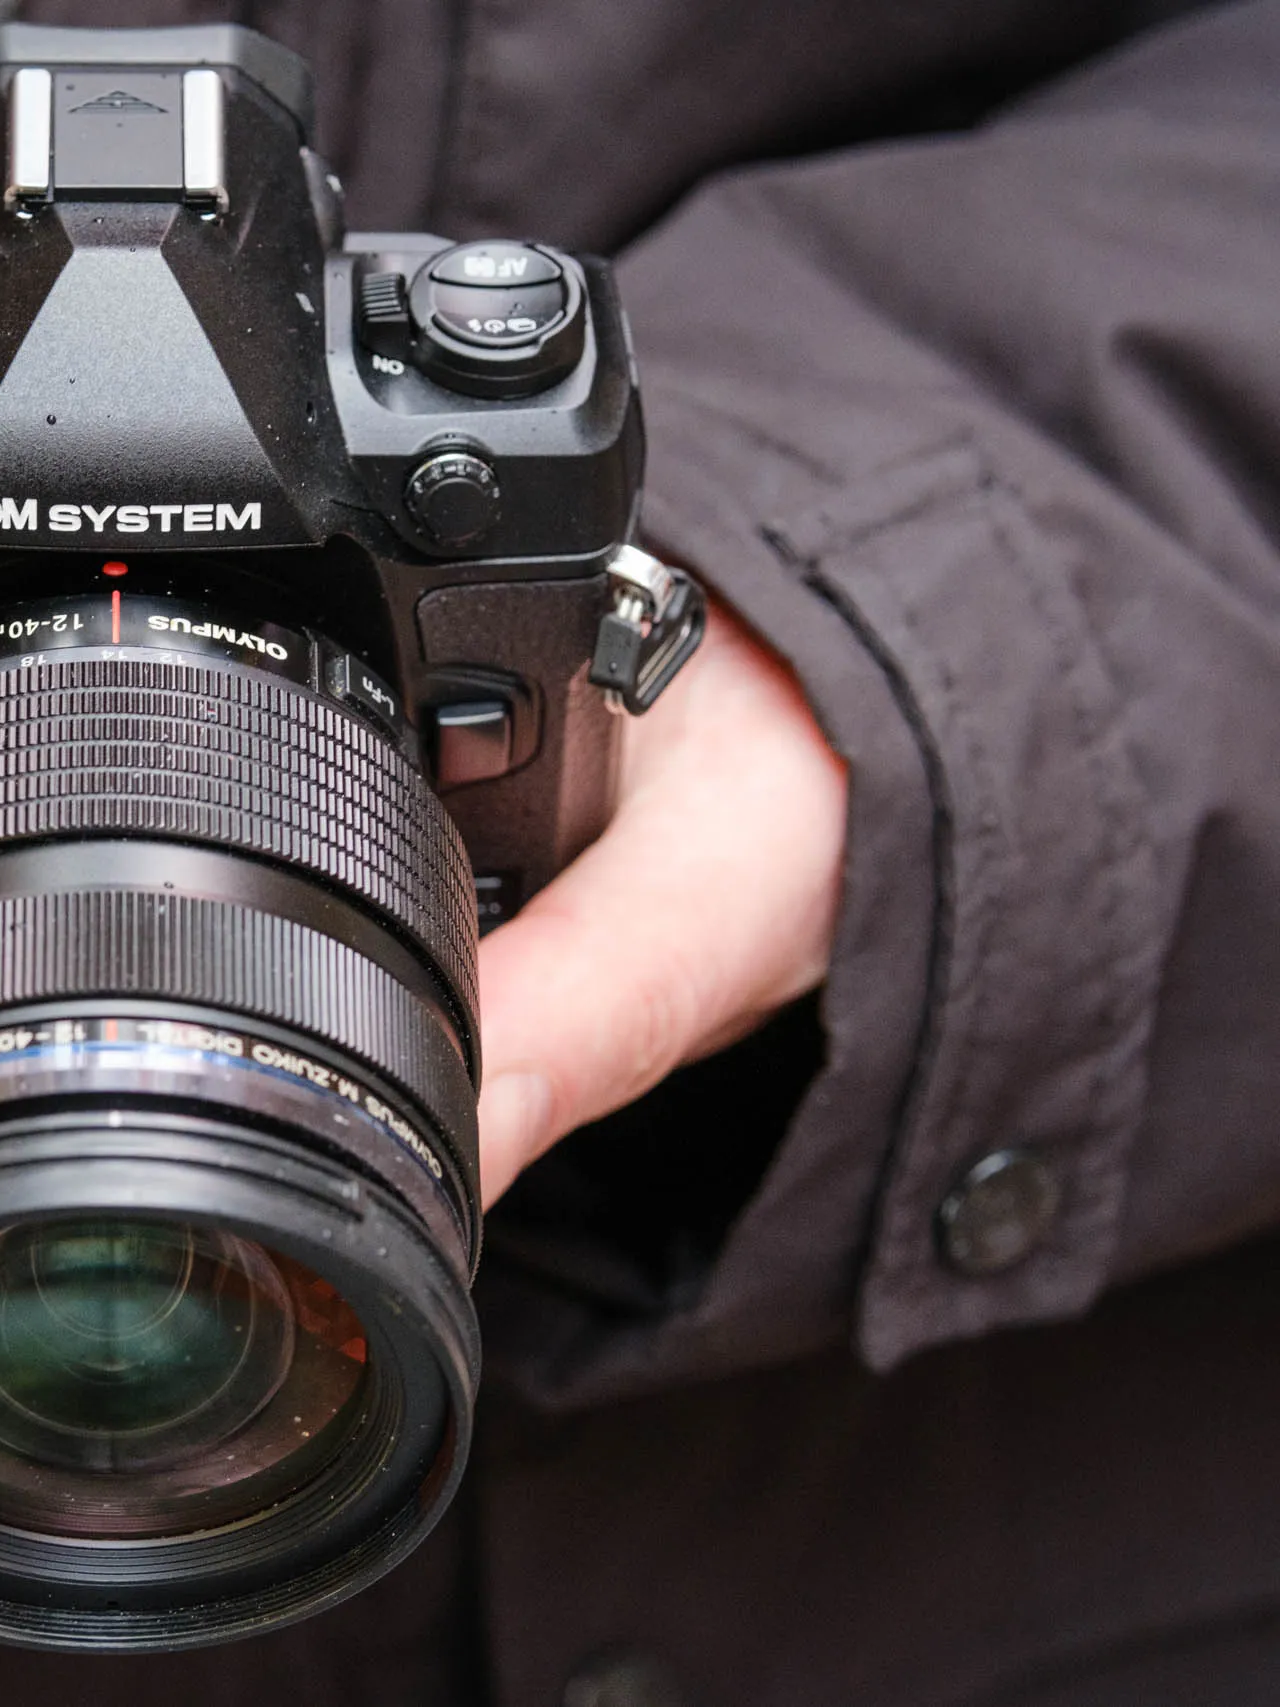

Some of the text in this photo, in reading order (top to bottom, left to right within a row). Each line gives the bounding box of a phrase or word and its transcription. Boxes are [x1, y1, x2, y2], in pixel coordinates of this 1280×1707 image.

[498, 257, 528, 277] AF
[372, 355, 405, 376] ON
[48, 502, 262, 533] SYSTEM
[147, 614, 289, 661] OLYMPUS
[20, 654, 47, 668] 18
[362, 675, 395, 716] L-Fn
[364, 1095, 443, 1180] OLYMPUS
